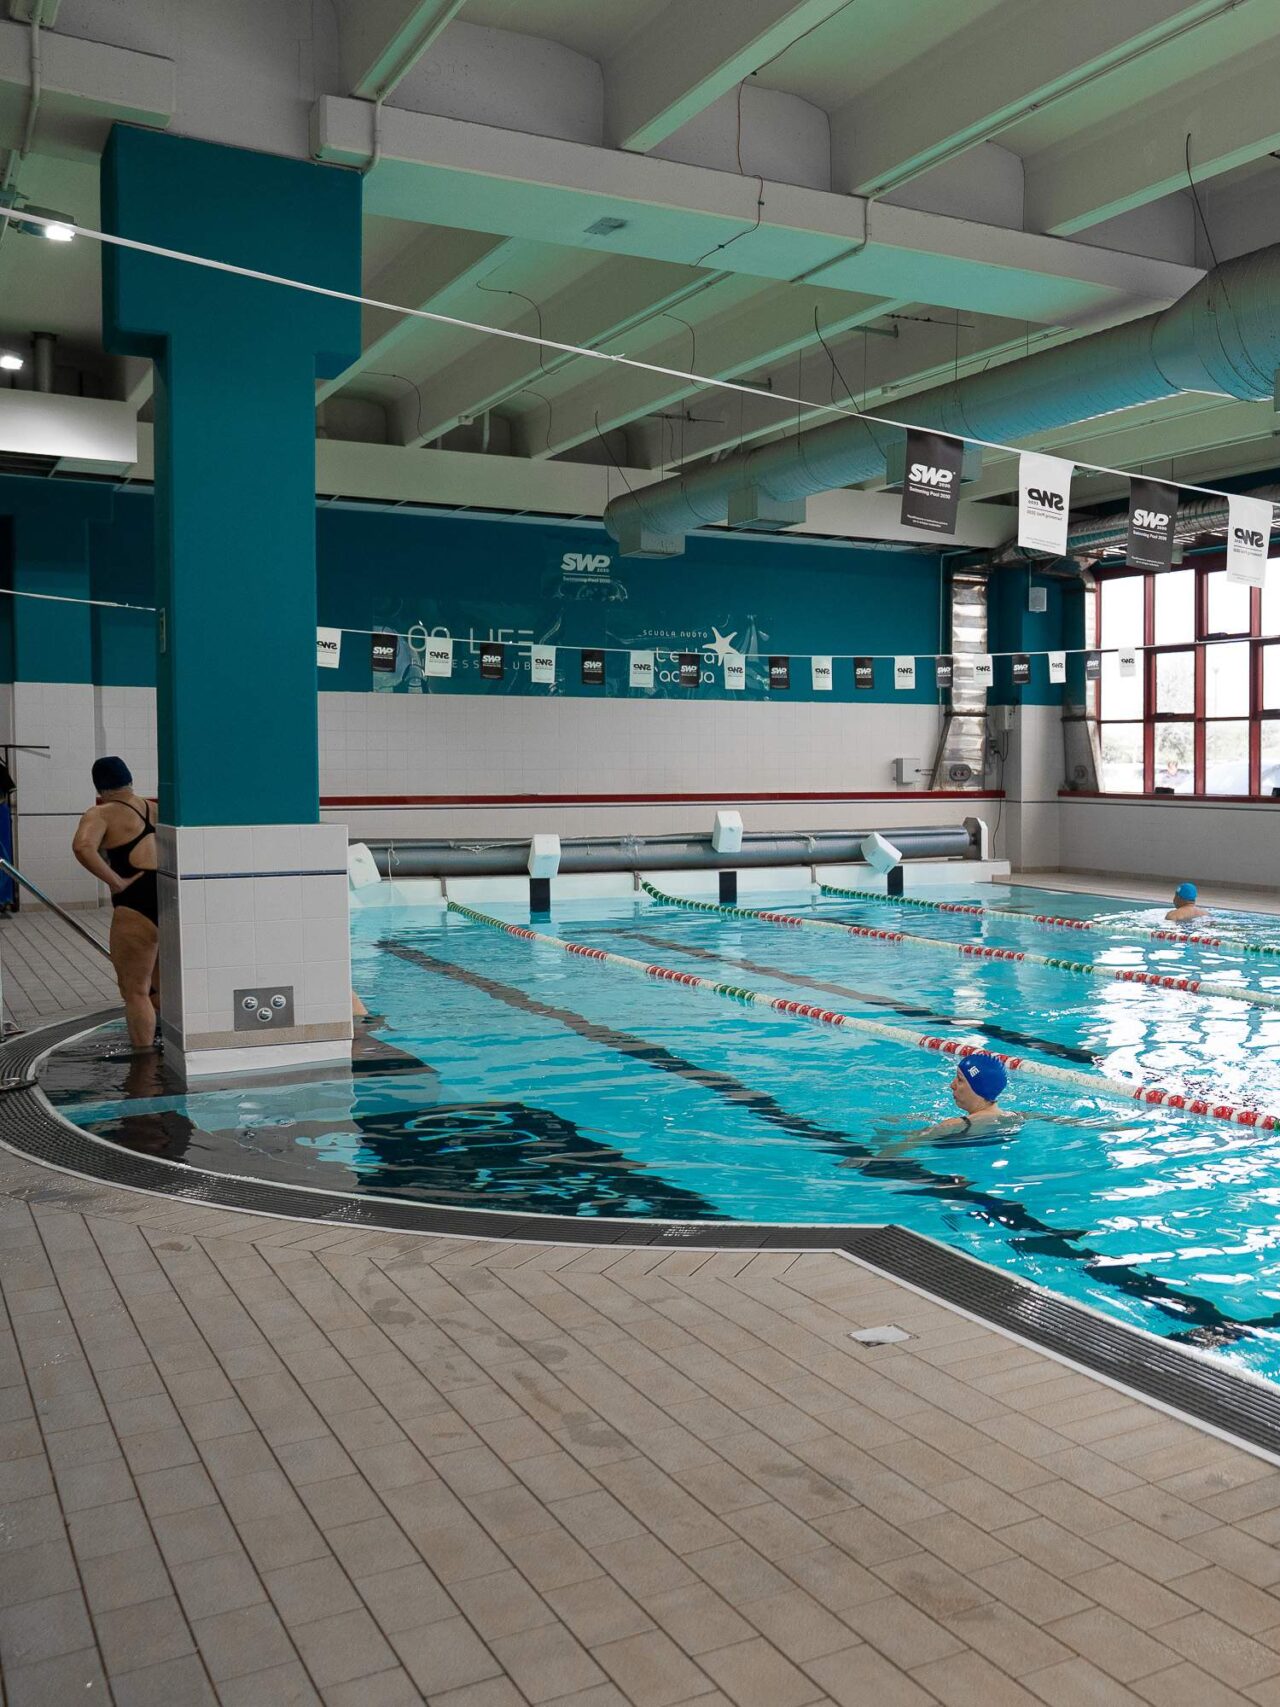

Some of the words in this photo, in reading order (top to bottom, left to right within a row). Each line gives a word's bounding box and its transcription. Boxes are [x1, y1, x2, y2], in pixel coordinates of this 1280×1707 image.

[908, 463, 953, 486] SWP
[1132, 509, 1169, 529] SWP
[560, 552, 611, 572] SWP
[372, 646, 394, 655] SWP
[482, 655, 501, 663] SWP
